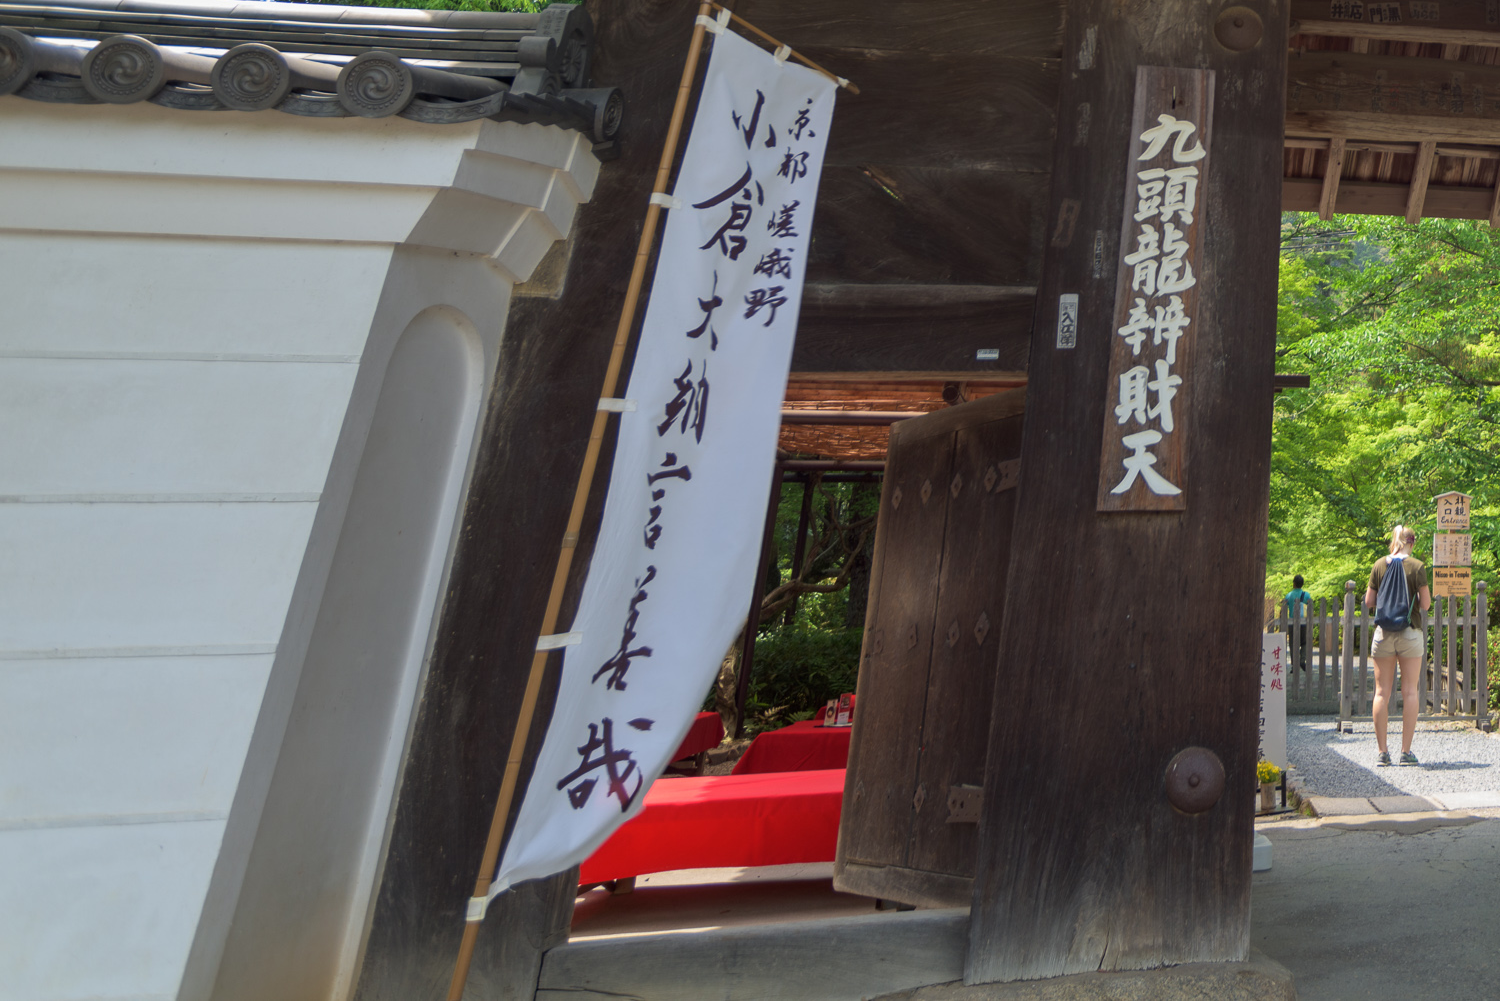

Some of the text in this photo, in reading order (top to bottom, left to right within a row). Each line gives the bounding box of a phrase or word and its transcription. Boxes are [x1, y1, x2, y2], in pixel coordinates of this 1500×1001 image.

[741, 97, 817, 328] 京都 嵯峨野
[555, 87, 776, 814] 小倉大納言善哉
[1440, 515, 1468, 524] Entrance
[1444, 499, 1452, 515] 入口
[1270, 646, 1283, 691] 甘味処
